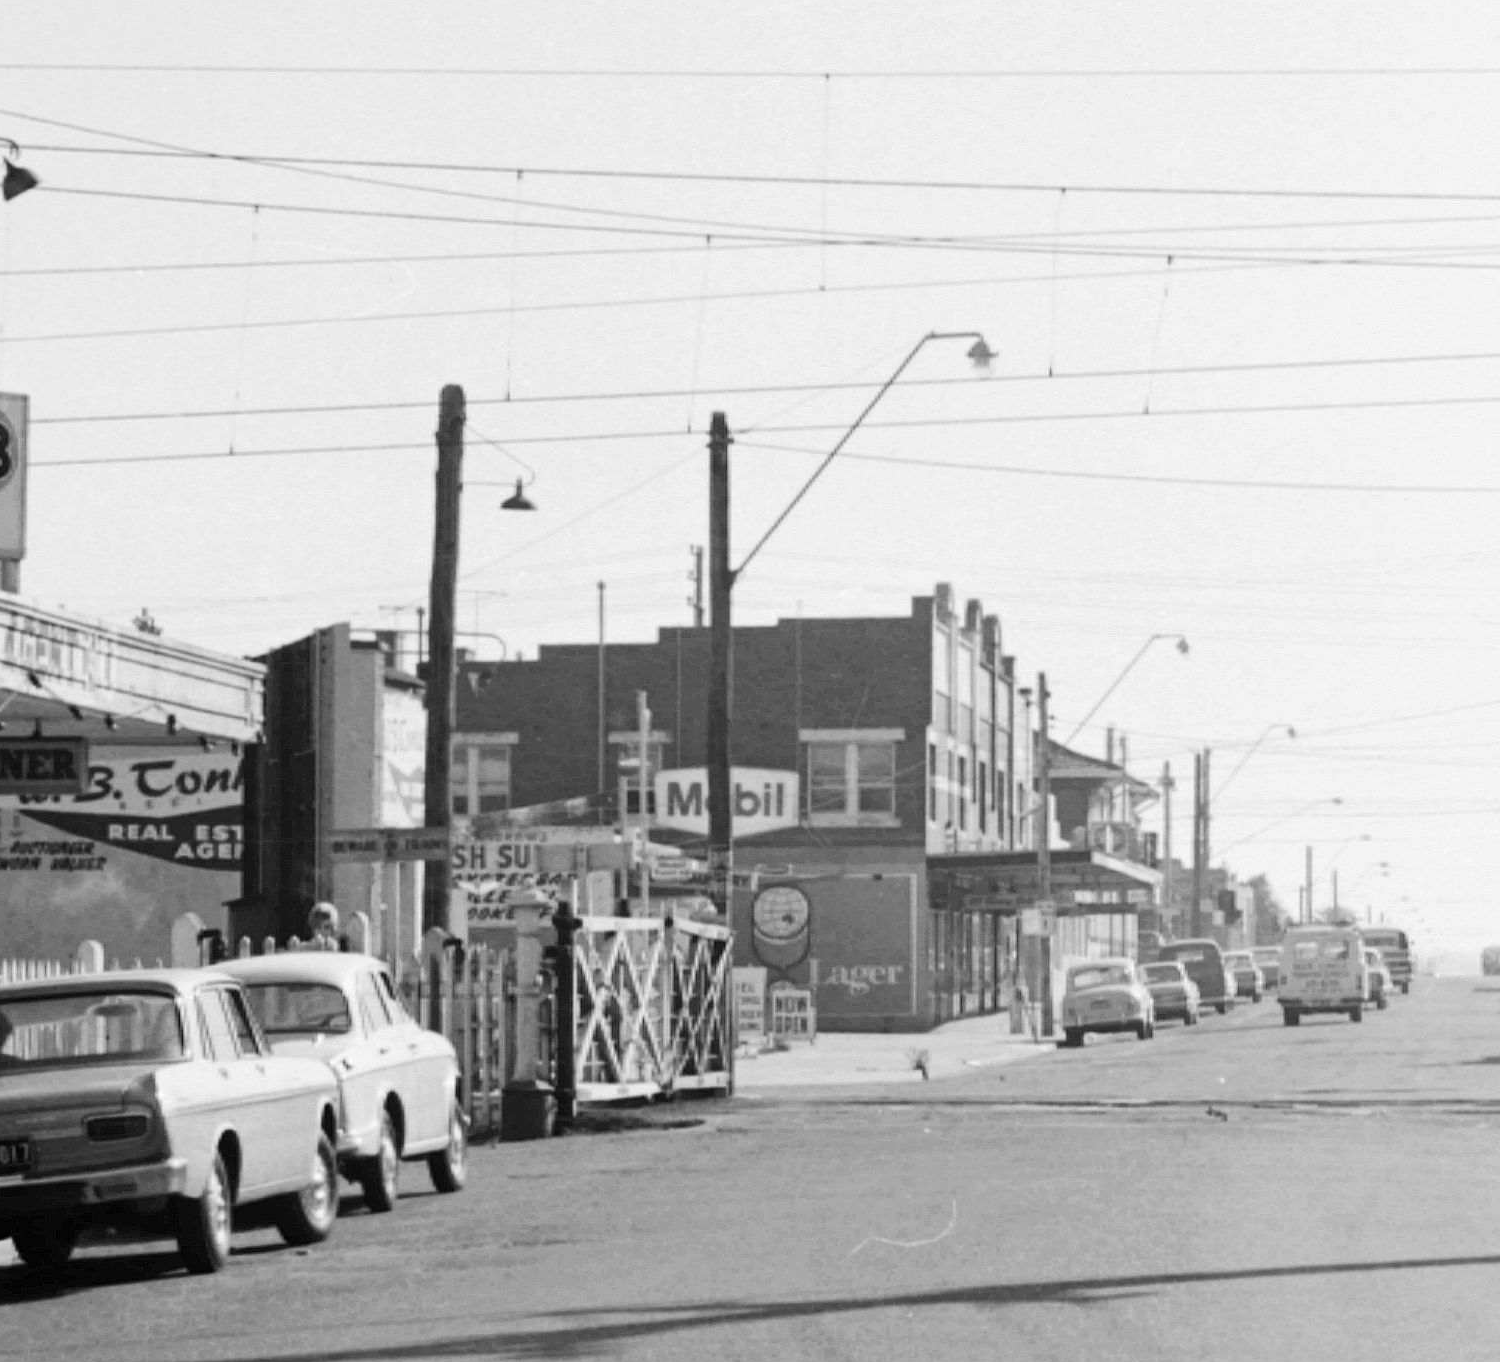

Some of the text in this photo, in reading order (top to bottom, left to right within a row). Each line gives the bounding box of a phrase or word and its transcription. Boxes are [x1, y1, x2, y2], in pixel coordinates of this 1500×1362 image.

[666, 781, 785, 817] Mbil
[108, 823, 175, 840] REAL
[808, 957, 904, 996] Lager
